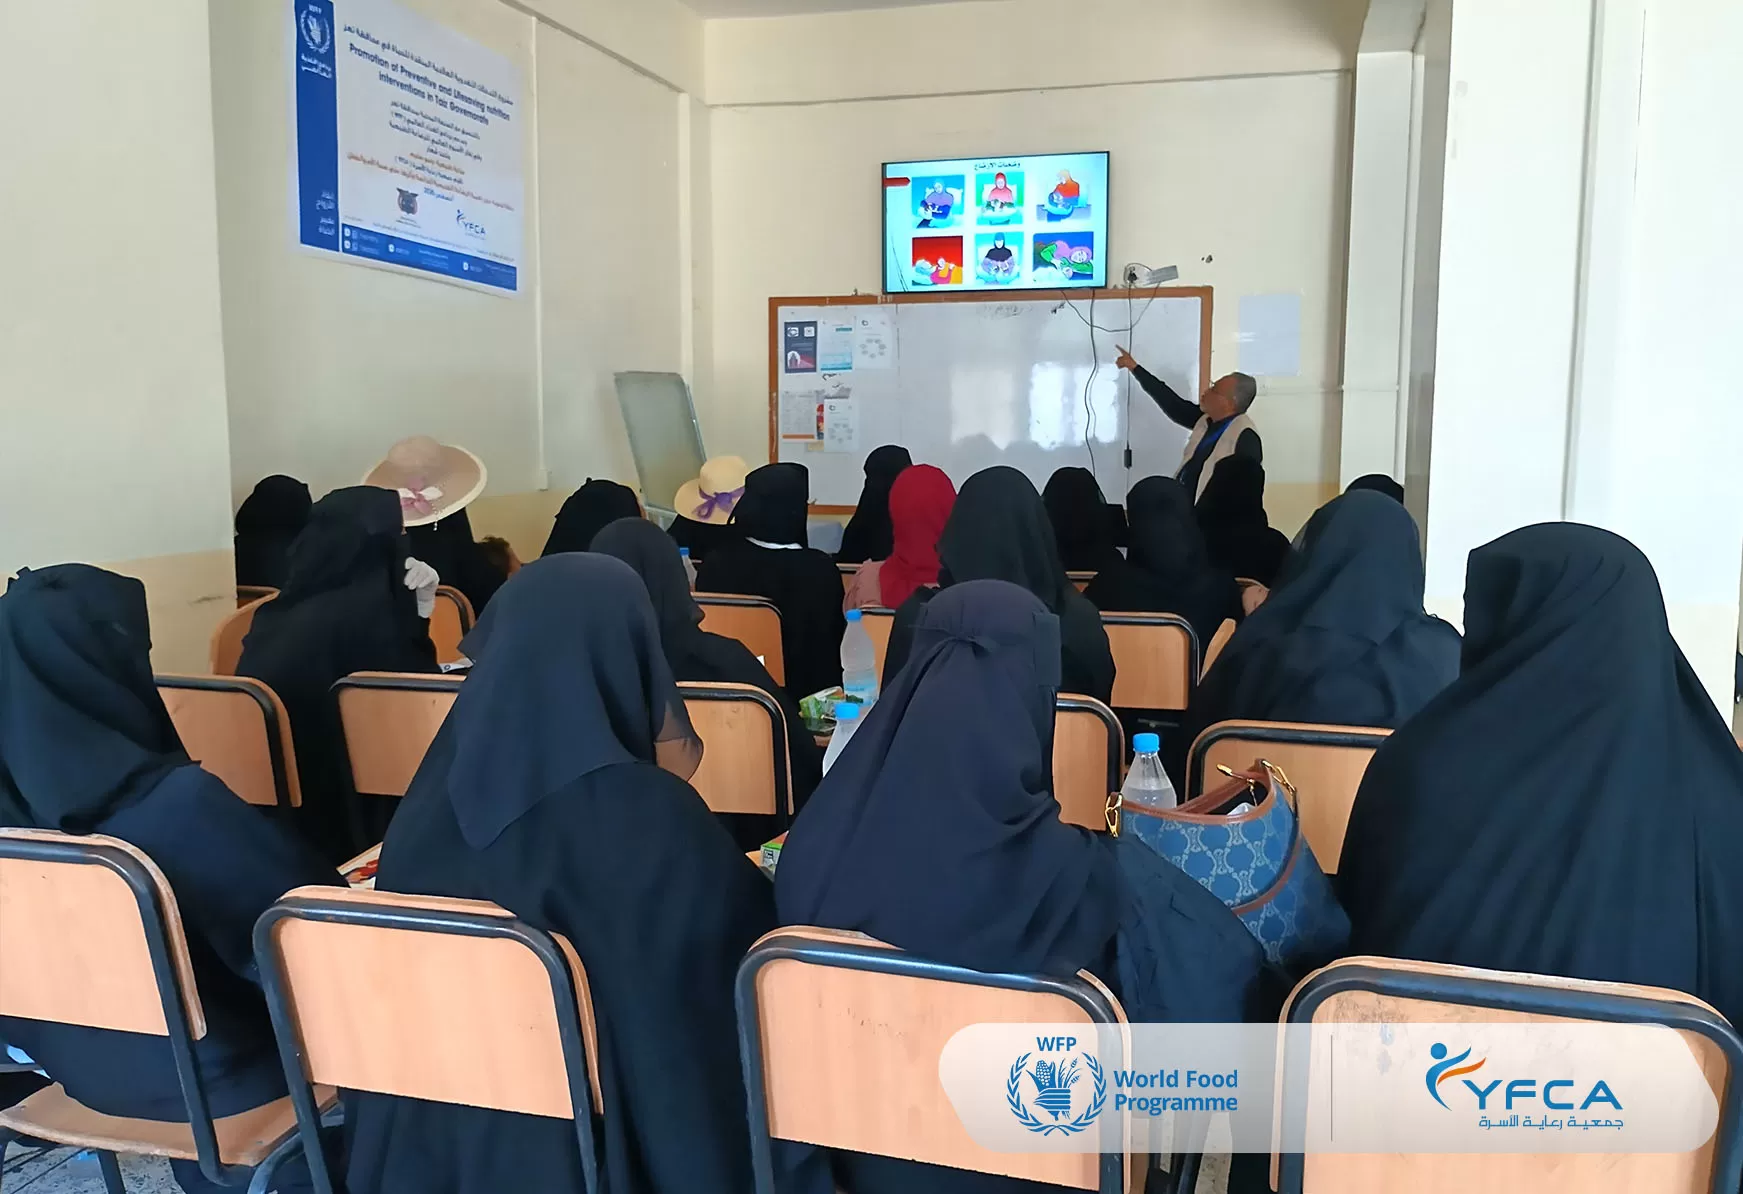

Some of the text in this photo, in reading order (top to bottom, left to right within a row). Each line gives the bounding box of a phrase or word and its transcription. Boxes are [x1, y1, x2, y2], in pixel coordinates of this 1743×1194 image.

[349, 43, 389, 70] Promotion
[391, 63, 399, 73] of
[400, 65, 437, 90] Preventive
[438, 84, 452, 97] and
[427, 92, 434, 102] in
